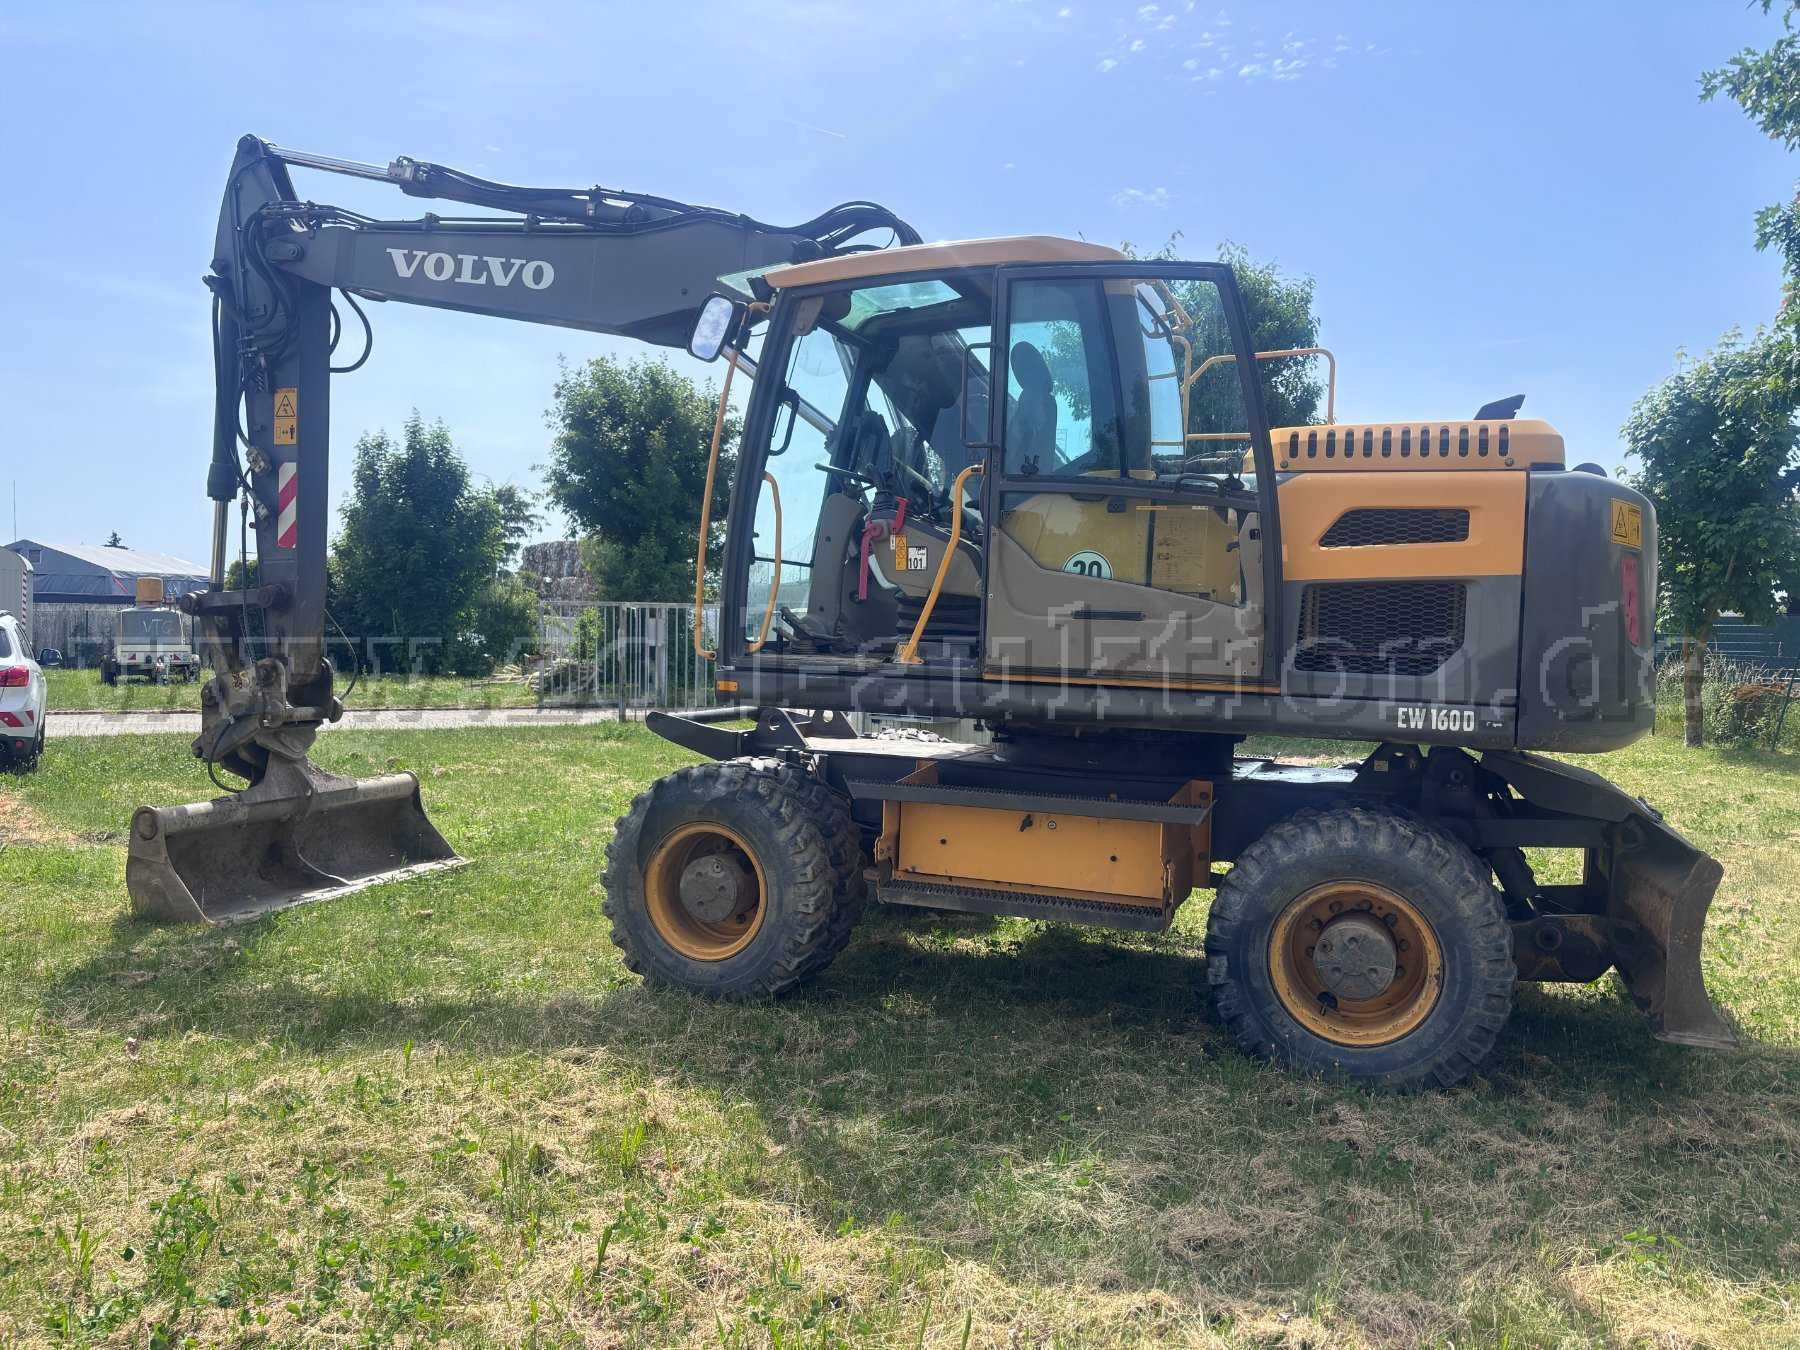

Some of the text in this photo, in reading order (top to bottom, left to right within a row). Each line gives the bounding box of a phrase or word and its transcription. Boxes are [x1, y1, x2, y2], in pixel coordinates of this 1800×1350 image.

[386, 247, 554, 290] VOLVO
[908, 557, 923, 569] 101
[1072, 559, 1102, 578] 20
[1397, 706, 1475, 732] EW 160D
